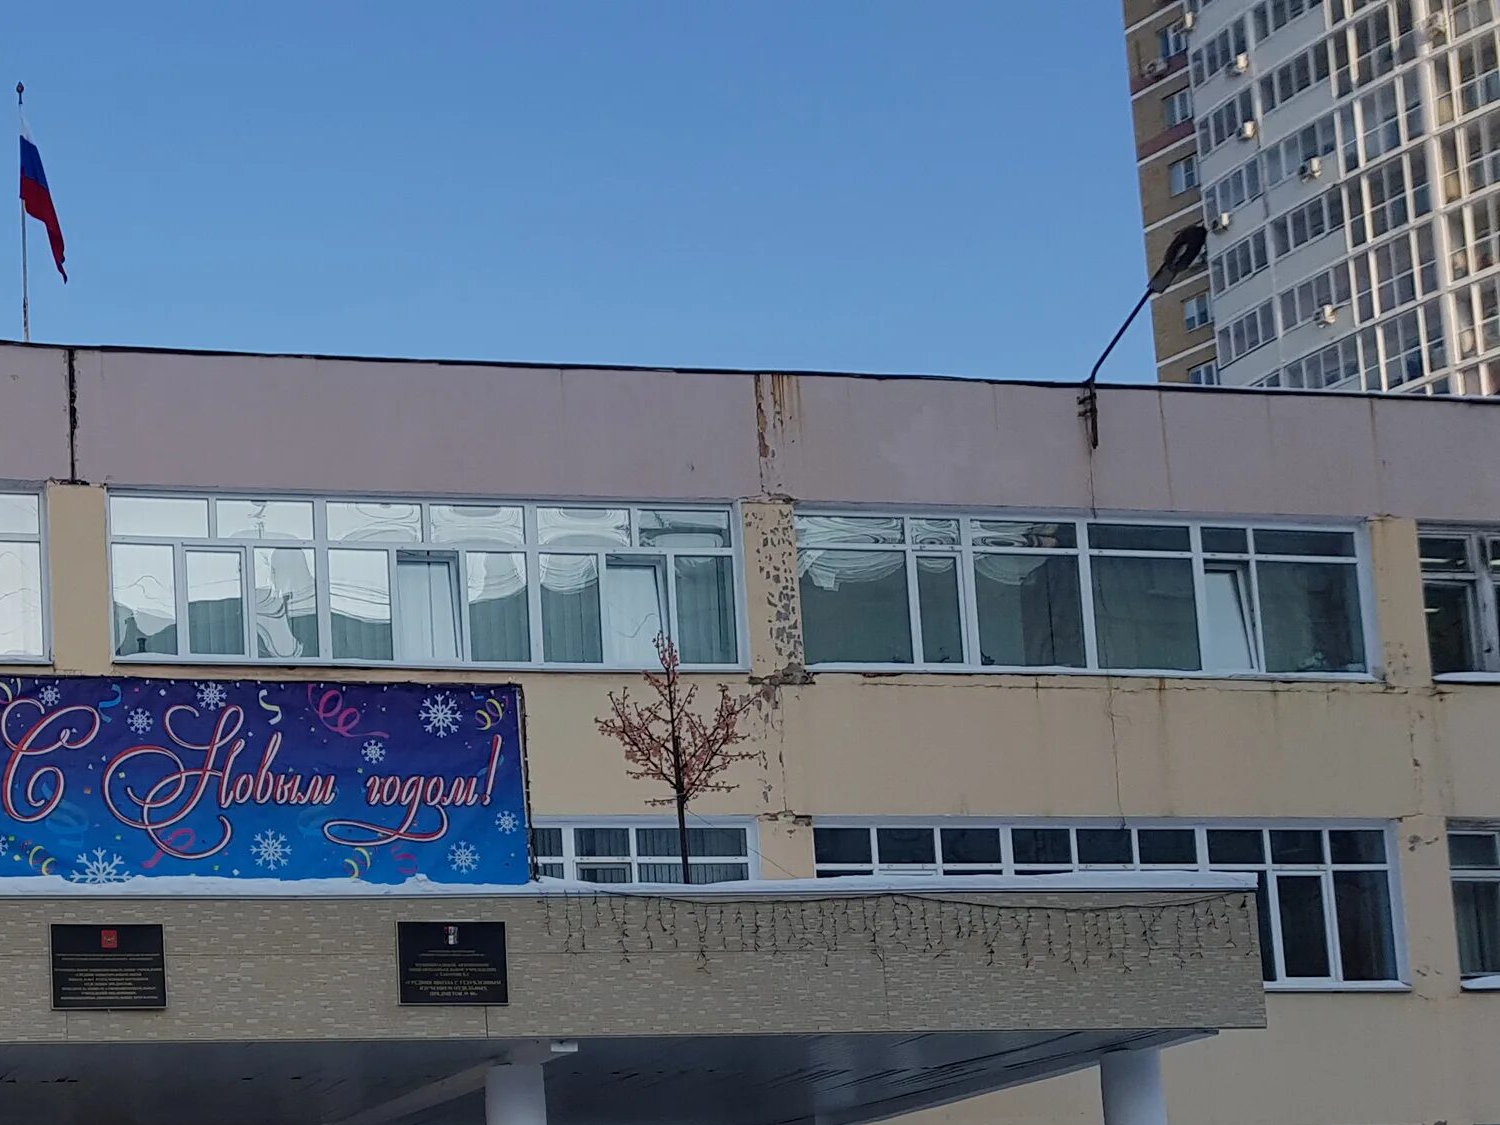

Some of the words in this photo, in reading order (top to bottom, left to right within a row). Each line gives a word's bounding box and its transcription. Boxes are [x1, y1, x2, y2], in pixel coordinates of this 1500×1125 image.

[0, 698, 100, 823] С
[103, 704, 336, 859] Новым
[324, 733, 503, 846] годом!
